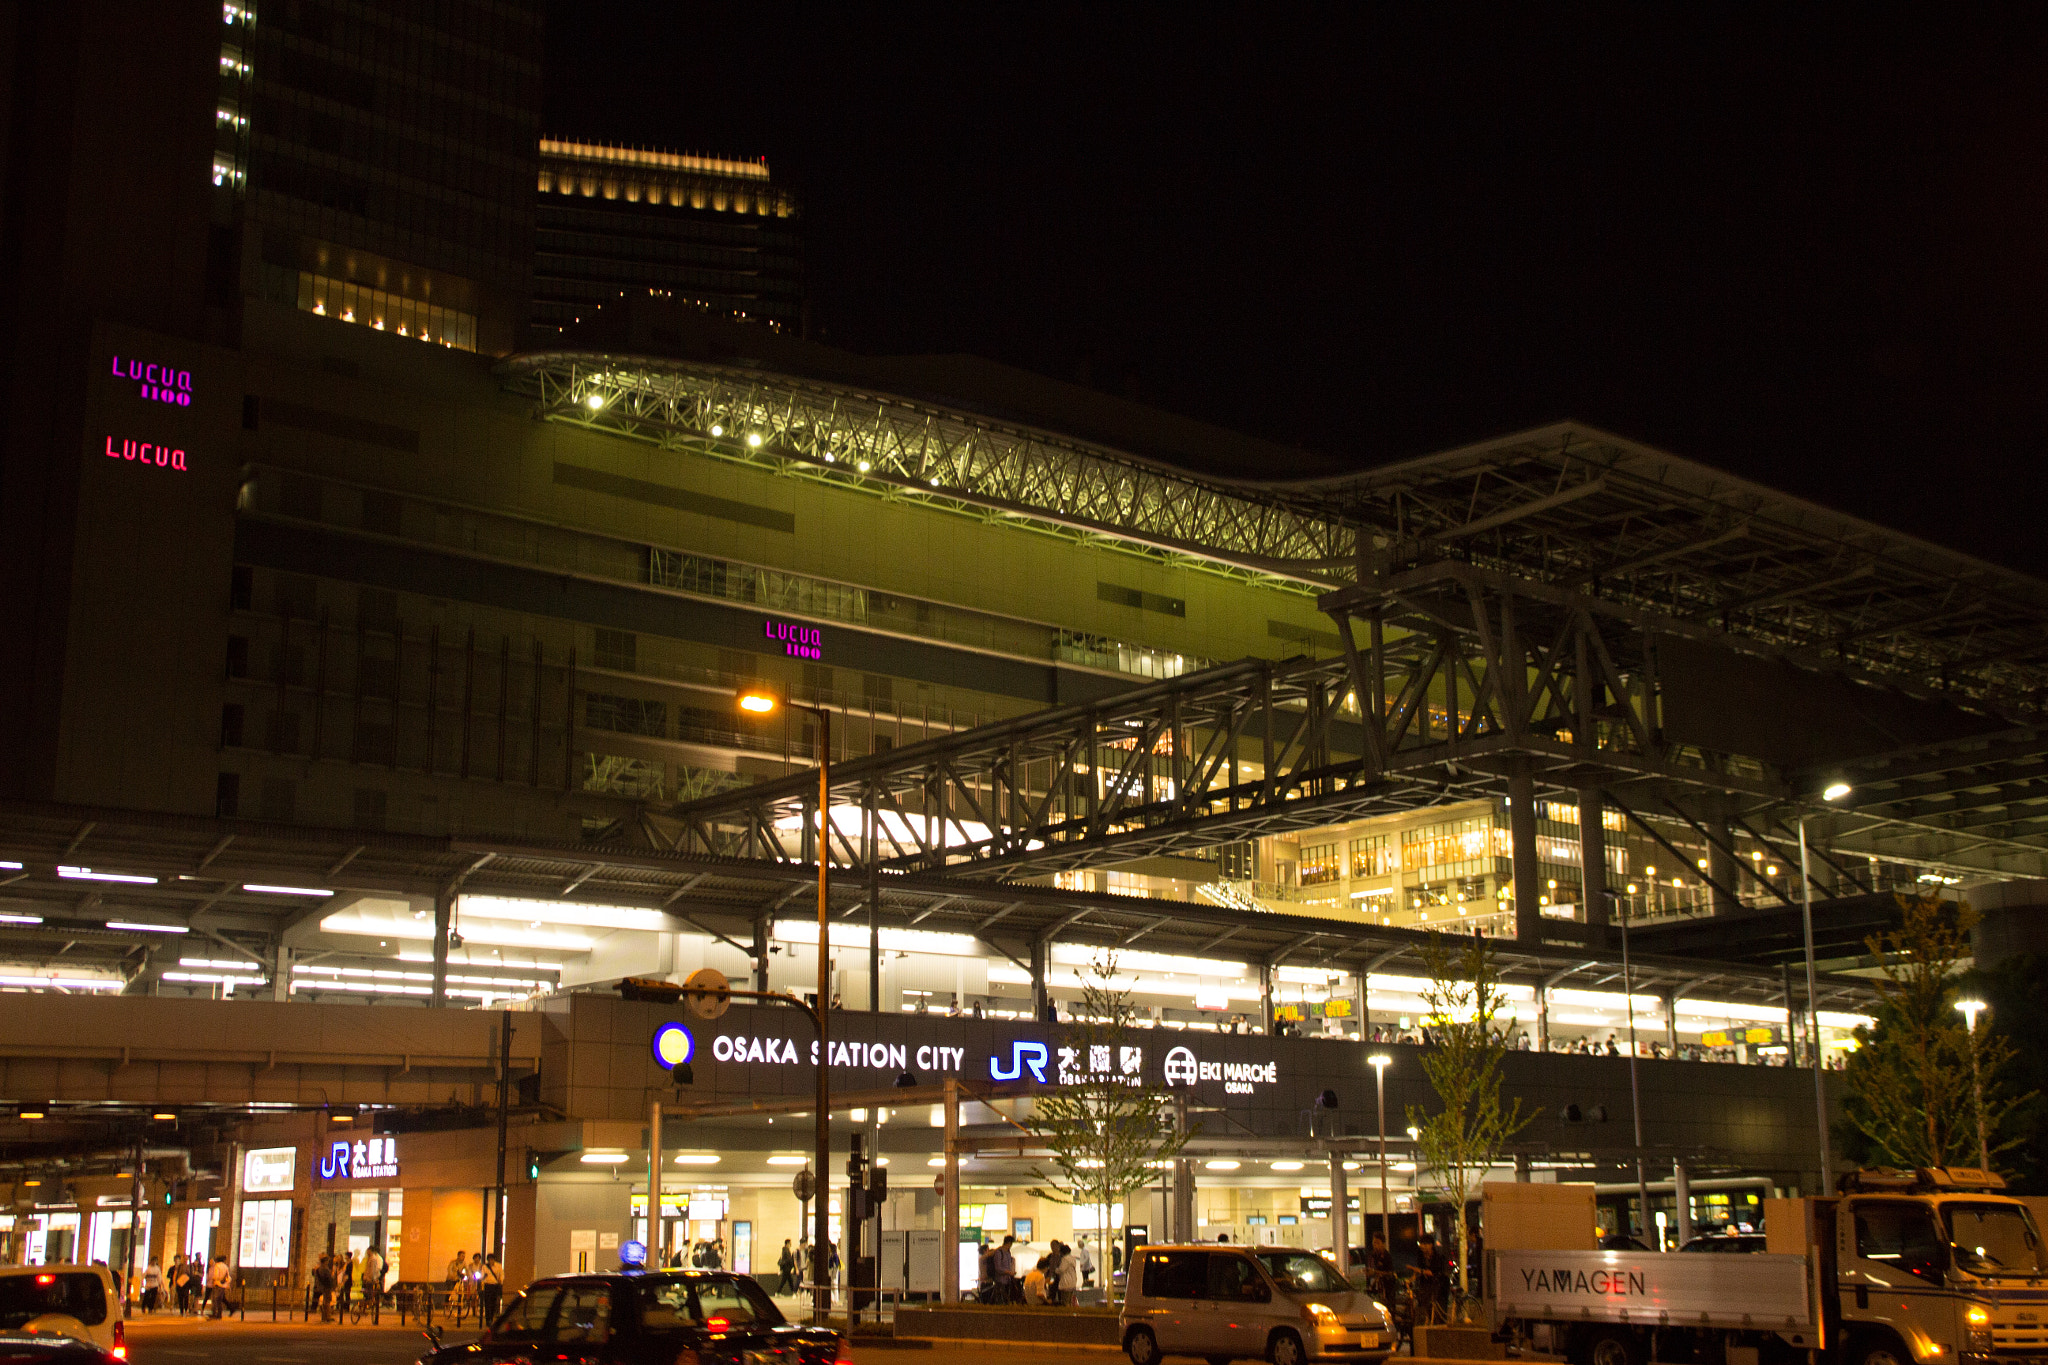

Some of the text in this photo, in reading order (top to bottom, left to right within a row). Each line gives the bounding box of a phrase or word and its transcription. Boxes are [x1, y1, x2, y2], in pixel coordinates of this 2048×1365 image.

[141, 383, 191, 407] 1100
[786, 642, 821, 660] 1100
[712, 1035, 965, 1071] OSAKA STATION CITY
[989, 1040, 1048, 1083] JR
[1199, 1061, 1277, 1083] EKI MARCHÉ
[1225, 1081, 1254, 1094] OSAKA
[320, 1141, 350, 1180] JR
[1521, 1268, 1646, 1296] YAMAGEN
